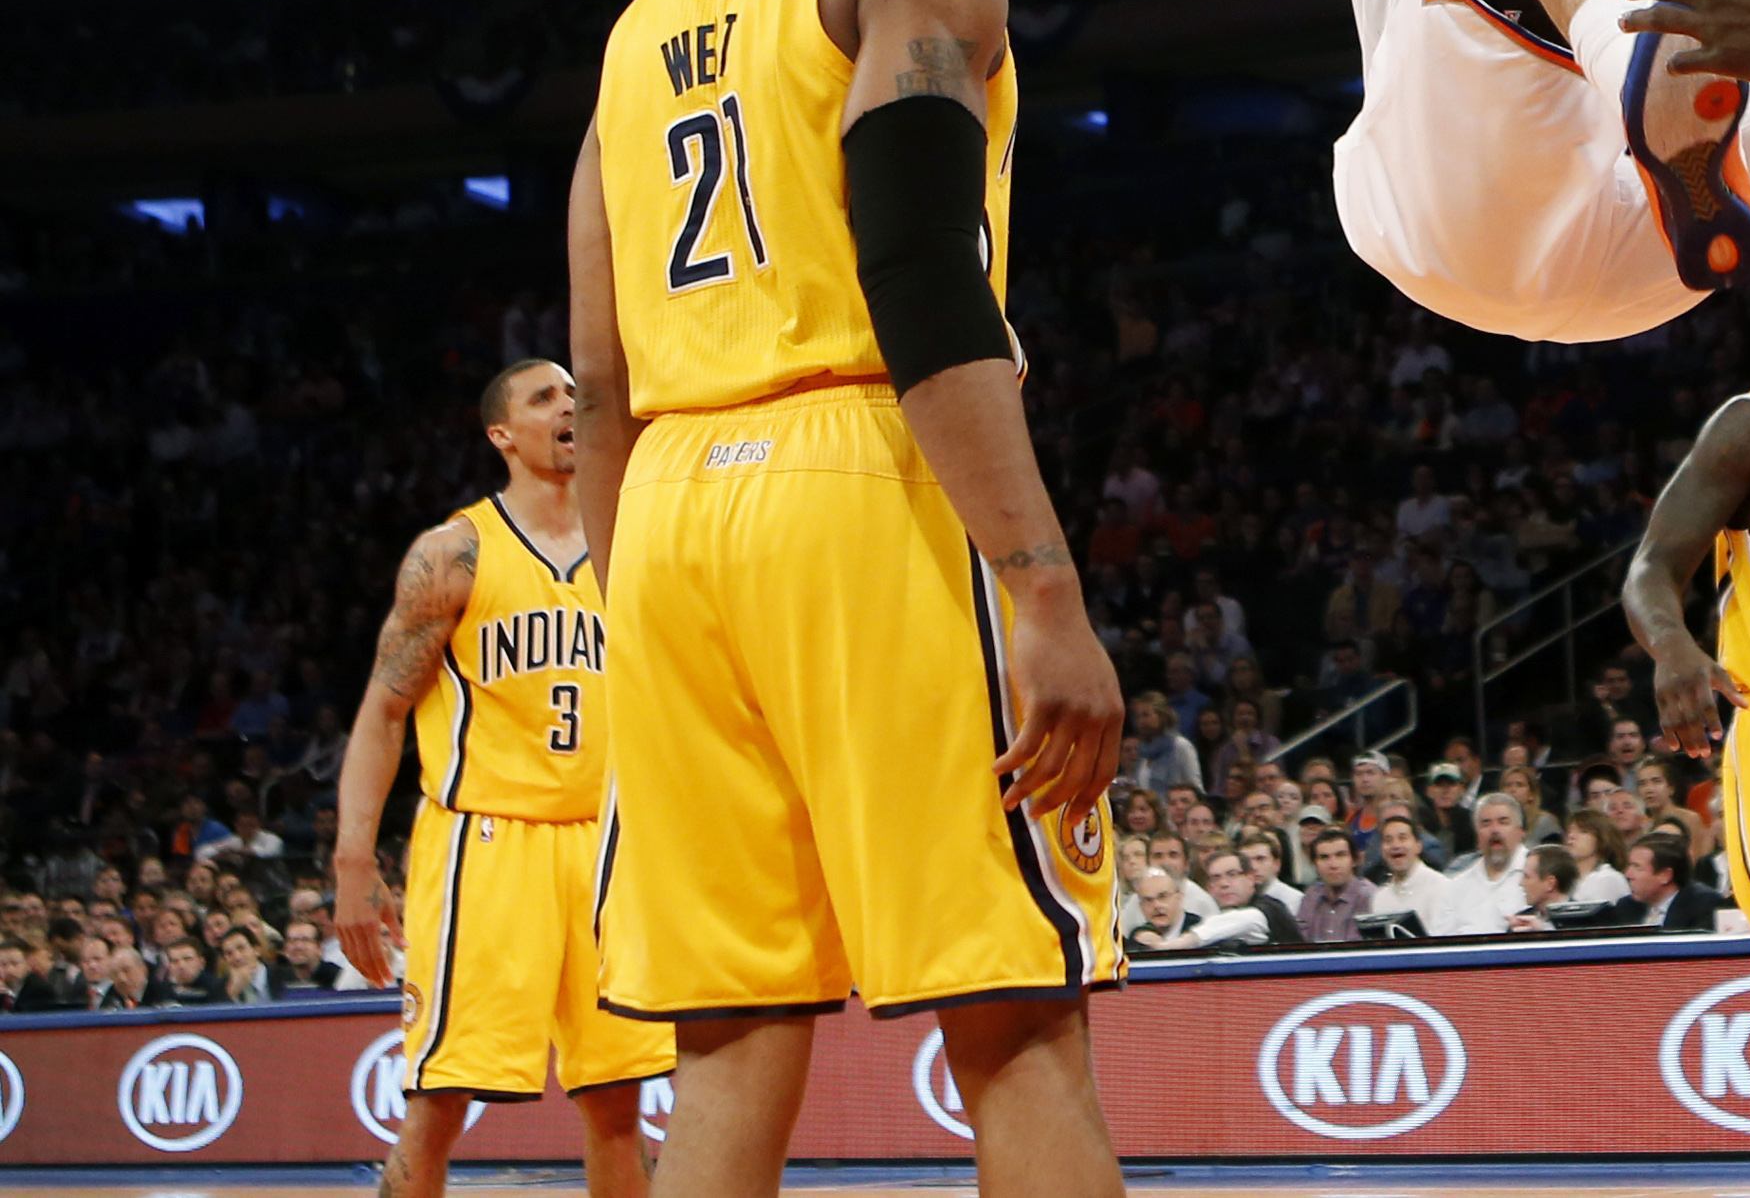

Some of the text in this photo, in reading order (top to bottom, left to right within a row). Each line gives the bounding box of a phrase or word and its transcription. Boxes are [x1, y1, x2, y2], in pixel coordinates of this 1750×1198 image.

[660, 13, 737, 97] WET
[666, 91, 770, 294] 21
[547, 682, 582, 754] 3
[138, 1059, 221, 1124] KIA
[1292, 1023, 1432, 1106] KIA
